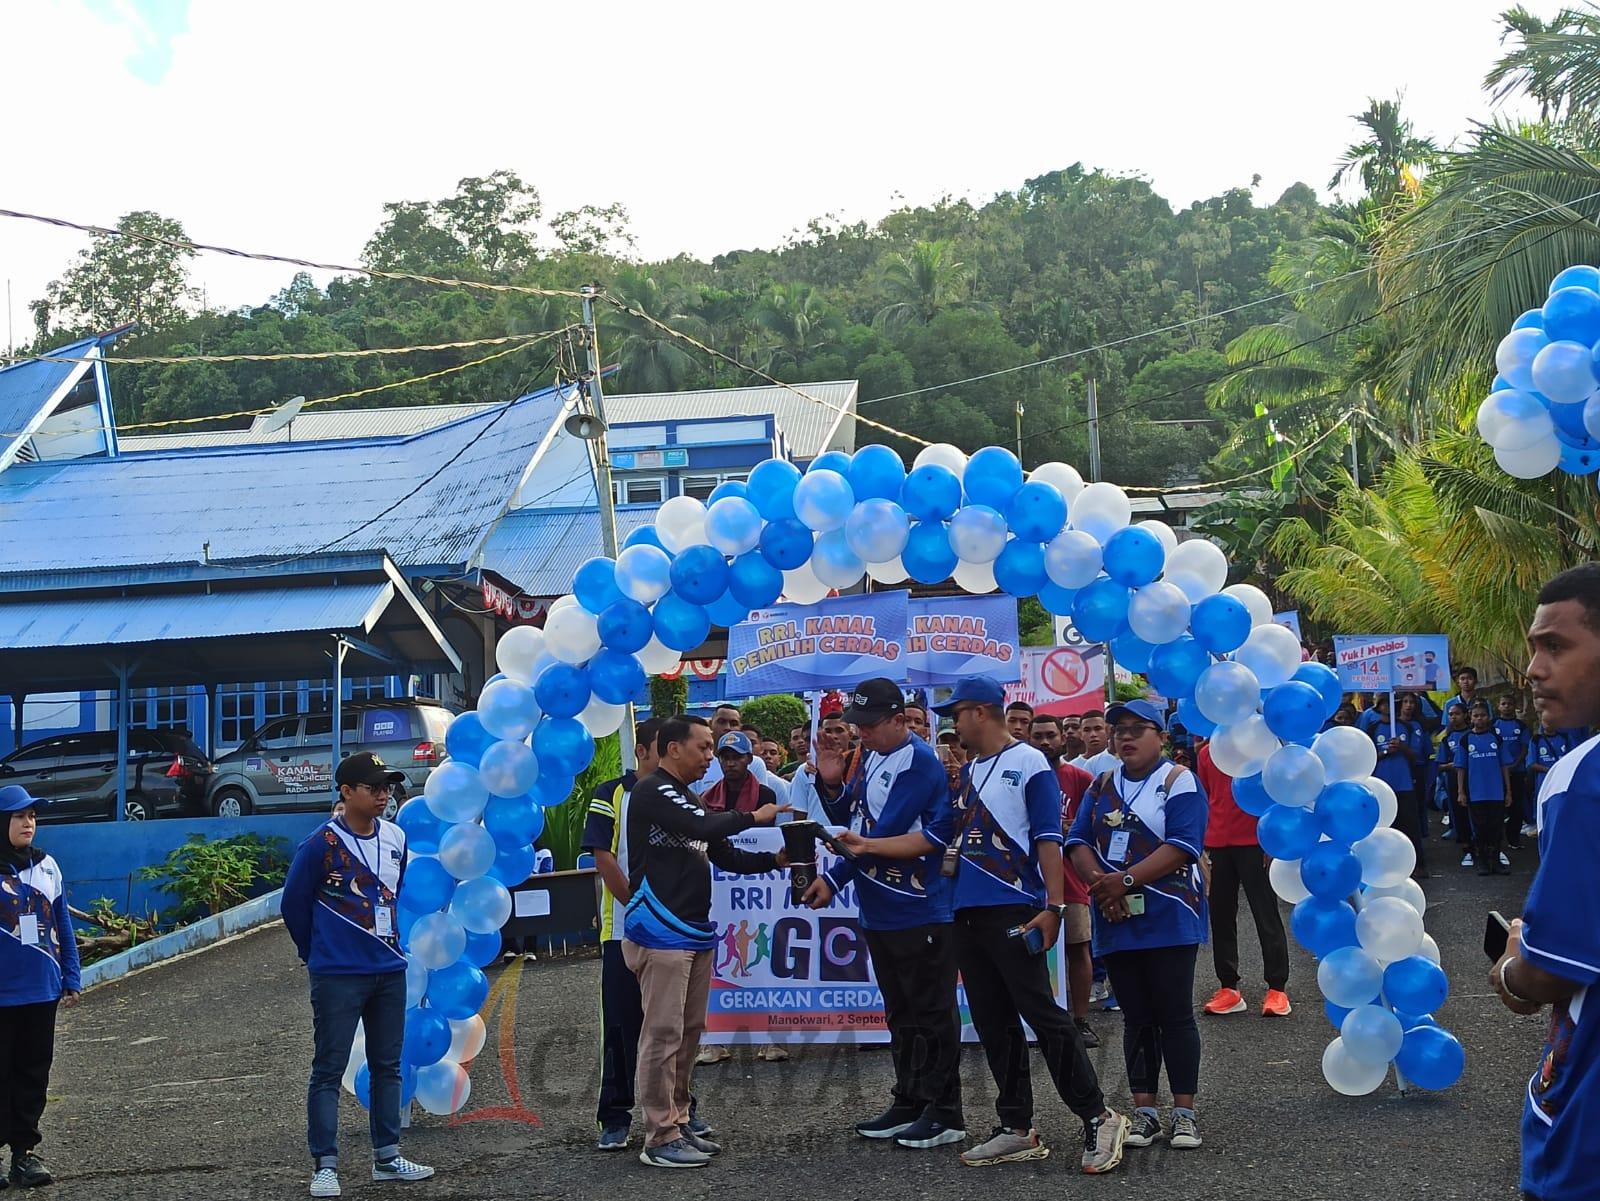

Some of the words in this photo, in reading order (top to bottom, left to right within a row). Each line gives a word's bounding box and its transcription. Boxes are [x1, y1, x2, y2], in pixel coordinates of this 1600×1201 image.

[805, 616, 875, 636] KANAL
[914, 616, 986, 636] KANAL
[733, 637, 815, 677] PEMILIH
[820, 636, 900, 662] CERDAS
[930, 636, 1012, 662] CERDAS
[1367, 640, 1406, 656] Nyoblos
[1360, 661, 1379, 675] 14
[278, 766, 323, 776] KANAL
[731, 887, 772, 910] RRI
[720, 990, 811, 1009] GERAKAN
[819, 990, 886, 1008] CERDA
[768, 1014, 834, 1027] Manokwari,
[836, 1014, 844, 1025] 2
